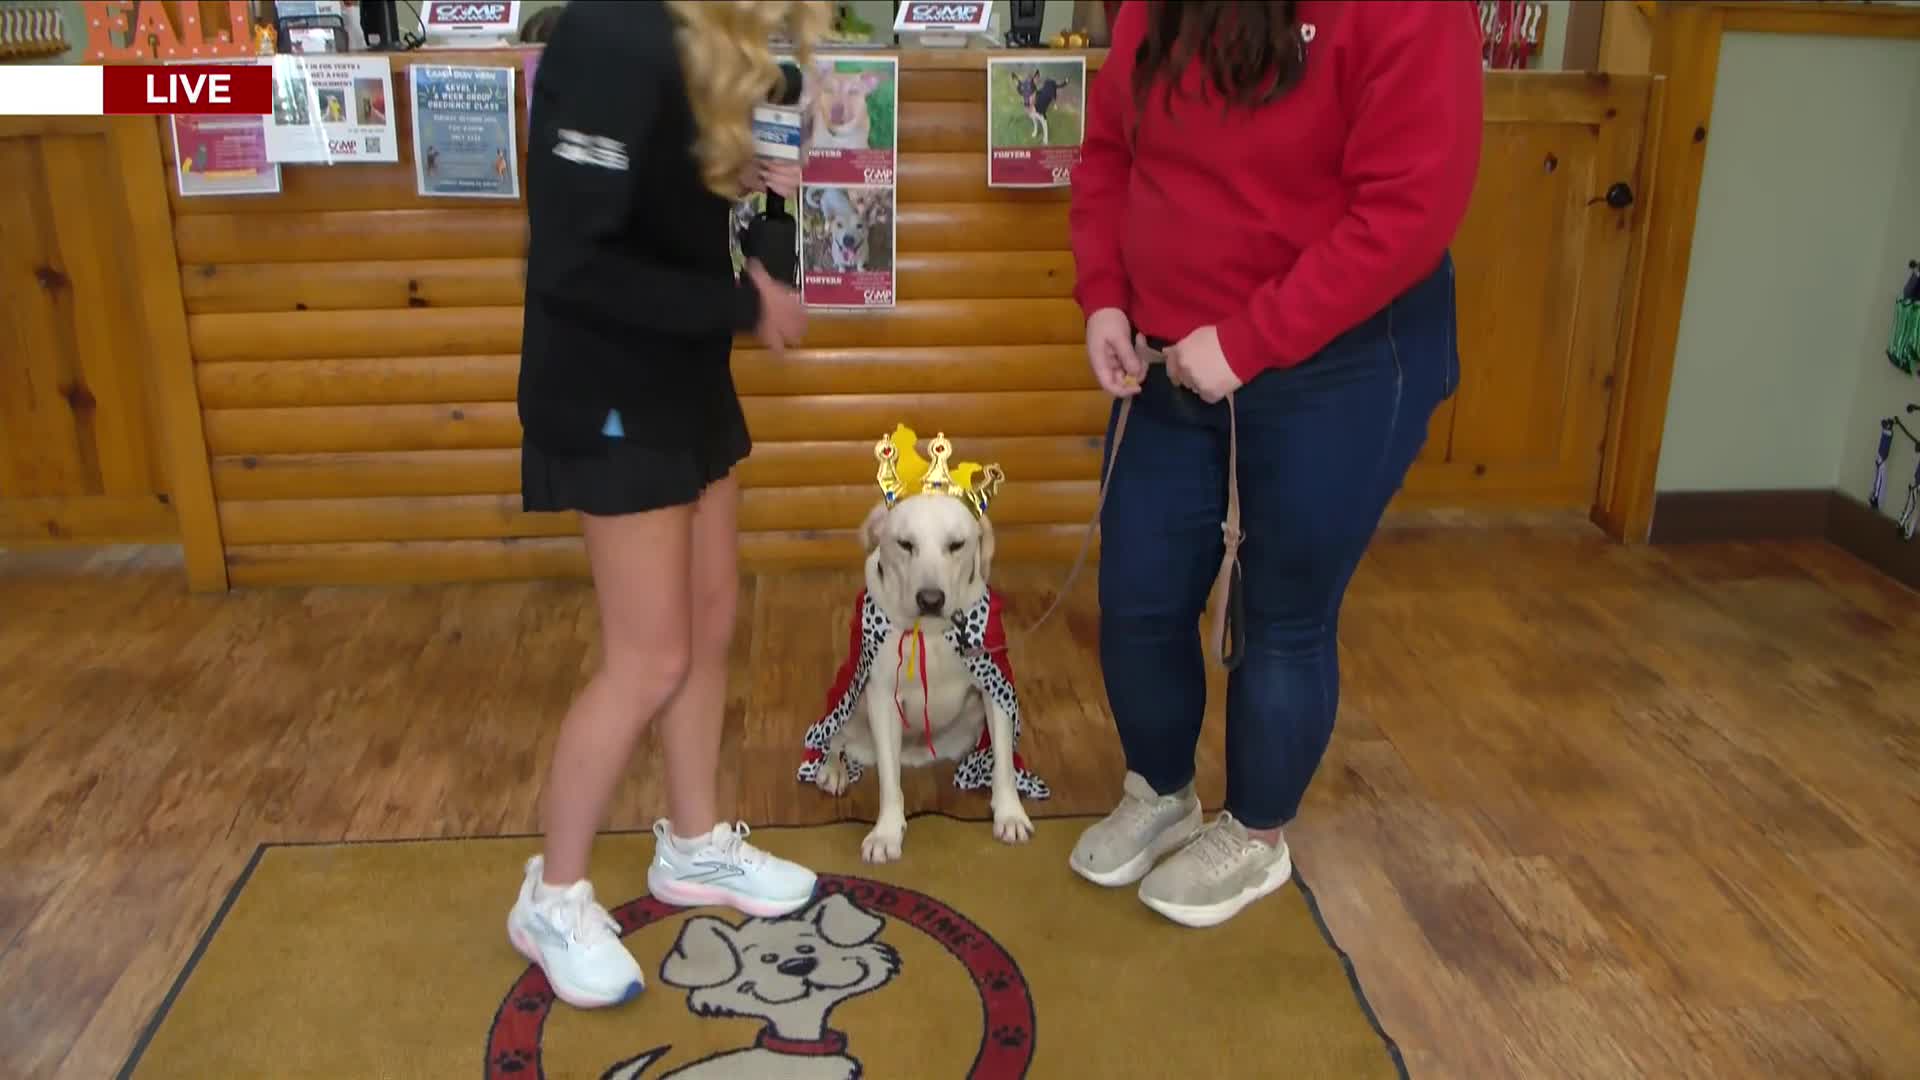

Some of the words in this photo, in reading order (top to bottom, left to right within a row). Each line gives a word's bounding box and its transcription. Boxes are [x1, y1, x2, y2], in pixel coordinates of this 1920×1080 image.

[436, 4, 505, 16] CAMP
[912, 5, 978, 16] CAMP
[445, 83, 470, 93] LEVEL
[466, 93, 491, 101] GROUP
[428, 100, 471, 110] OBEDIENCE
[474, 102, 500, 111] CLASS
[328, 139, 357, 150] CAMP
[864, 167, 893, 178] CAMP
[864, 289, 892, 300] CAMP
[822, 880, 897, 906] OOD
